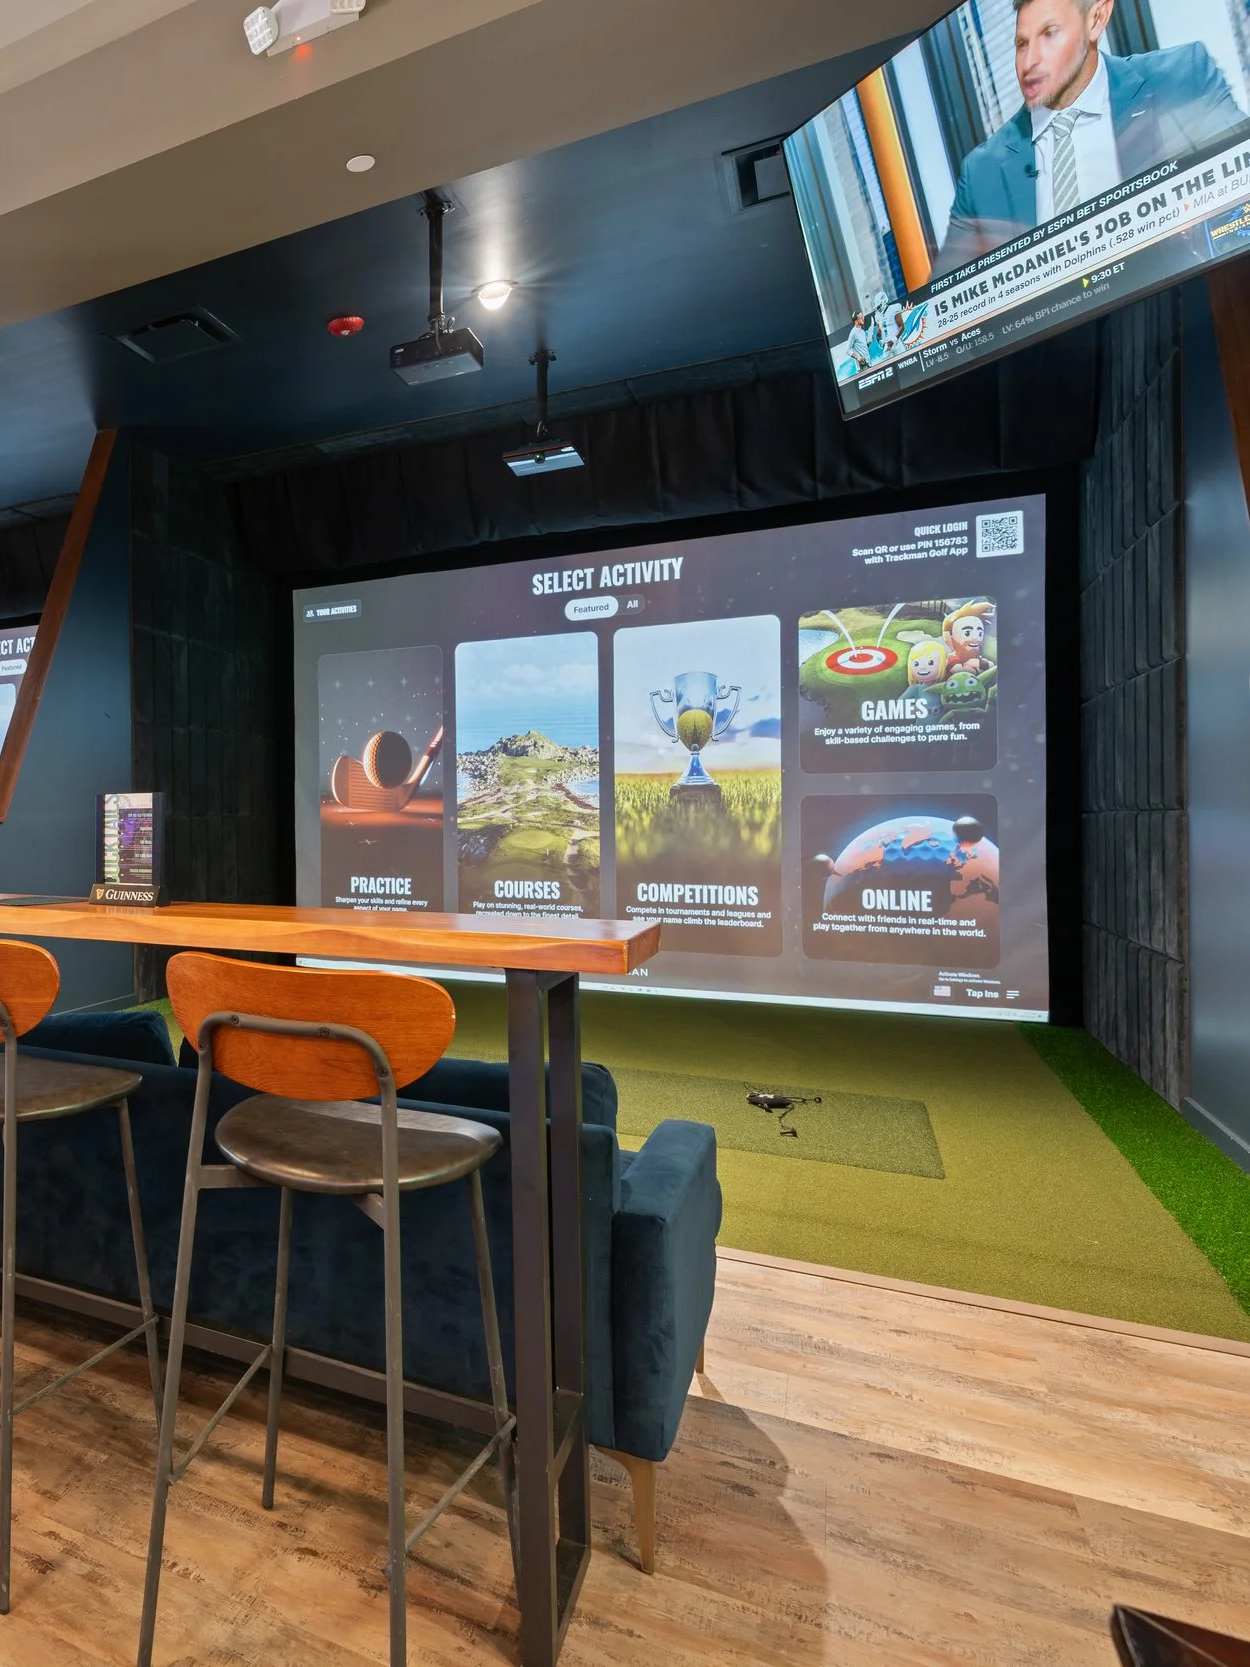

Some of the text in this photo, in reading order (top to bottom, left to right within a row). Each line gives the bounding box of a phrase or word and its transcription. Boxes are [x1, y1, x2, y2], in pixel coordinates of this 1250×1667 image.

[1194, 192, 1215, 208] MIA
[1218, 184, 1228, 197] at
[931, 161, 1178, 293] FIRST TAKE PRESENTED BY ESPN BET SPORTSBOOK
[934, 300, 948, 316] IS
[951, 280, 989, 308] MIKE
[992, 230, 1090, 288] McDANIEL'S
[1095, 211, 1132, 240] JOB
[1136, 192, 1167, 218] ON
[1172, 168, 1216, 200] THE
[938, 206, 1180, 328] 28-25 record in 4 seasons with Dolphins (.528 win pct)
[1091, 262, 1125, 284] 9:30 ET
[1002, 282, 1110, 336] LV: 64% BPI chance to win
[923, 328, 981, 358] Storm vs Aces
[974, 332, 994, 347] 158.5
[898, 356, 918, 370] WNBA
[926, 352, 949, 368] LV -8.5
[914, 520, 968, 537] QUICK LOGIN
[852, 548, 874, 557] Scan
[874, 546, 888, 555] QR
[900, 544, 916, 552] use
[917, 540, 933, 550] PIN
[934, 536, 968, 547] 156783
[864, 546, 968, 565] with Trackman Golf App
[532, 556, 684, 596] SELECT ACTIVITY
[316, 604, 357, 616] YOUR ACTIVITIES
[574, 600, 638, 614] Featured All
[2, 664, 22, 672] Featured
[862, 698, 928, 721] GAMES
[814, 727, 836, 736] Enjoy
[844, 726, 872, 735] variety
[874, 725, 883, 733] of
[884, 724, 924, 734] engaging
[926, 724, 956, 732] games,
[958, 722, 980, 730] from
[825, 732, 968, 745] skill-based challenges to pure fun.
[350, 876, 412, 894] PRACTICE
[494, 880, 560, 900] COURSES
[106, 889, 154, 901] GUINNESS
[335, 896, 357, 904] Sharpen
[396, 898, 411, 906] refine
[637, 883, 758, 906] COMPETITIONS
[862, 888, 932, 912] ONLINE
[473, 901, 486, 909] Play
[496, 902, 523, 910] stunning,
[626, 906, 771, 918] Compete in tournaments and leagues and
[704, 918, 716, 926] the
[718, 918, 764, 928] leaderboard.
[822, 912, 976, 926] Connect with friends in real-time and
[814, 922, 830, 931] play
[832, 924, 867, 932] together
[890, 926, 930, 936] anywhere
[932, 928, 940, 936] in
[942, 928, 956, 936] the
[958, 929, 986, 938] world.
[966, 988, 999, 999] Tap Ins
